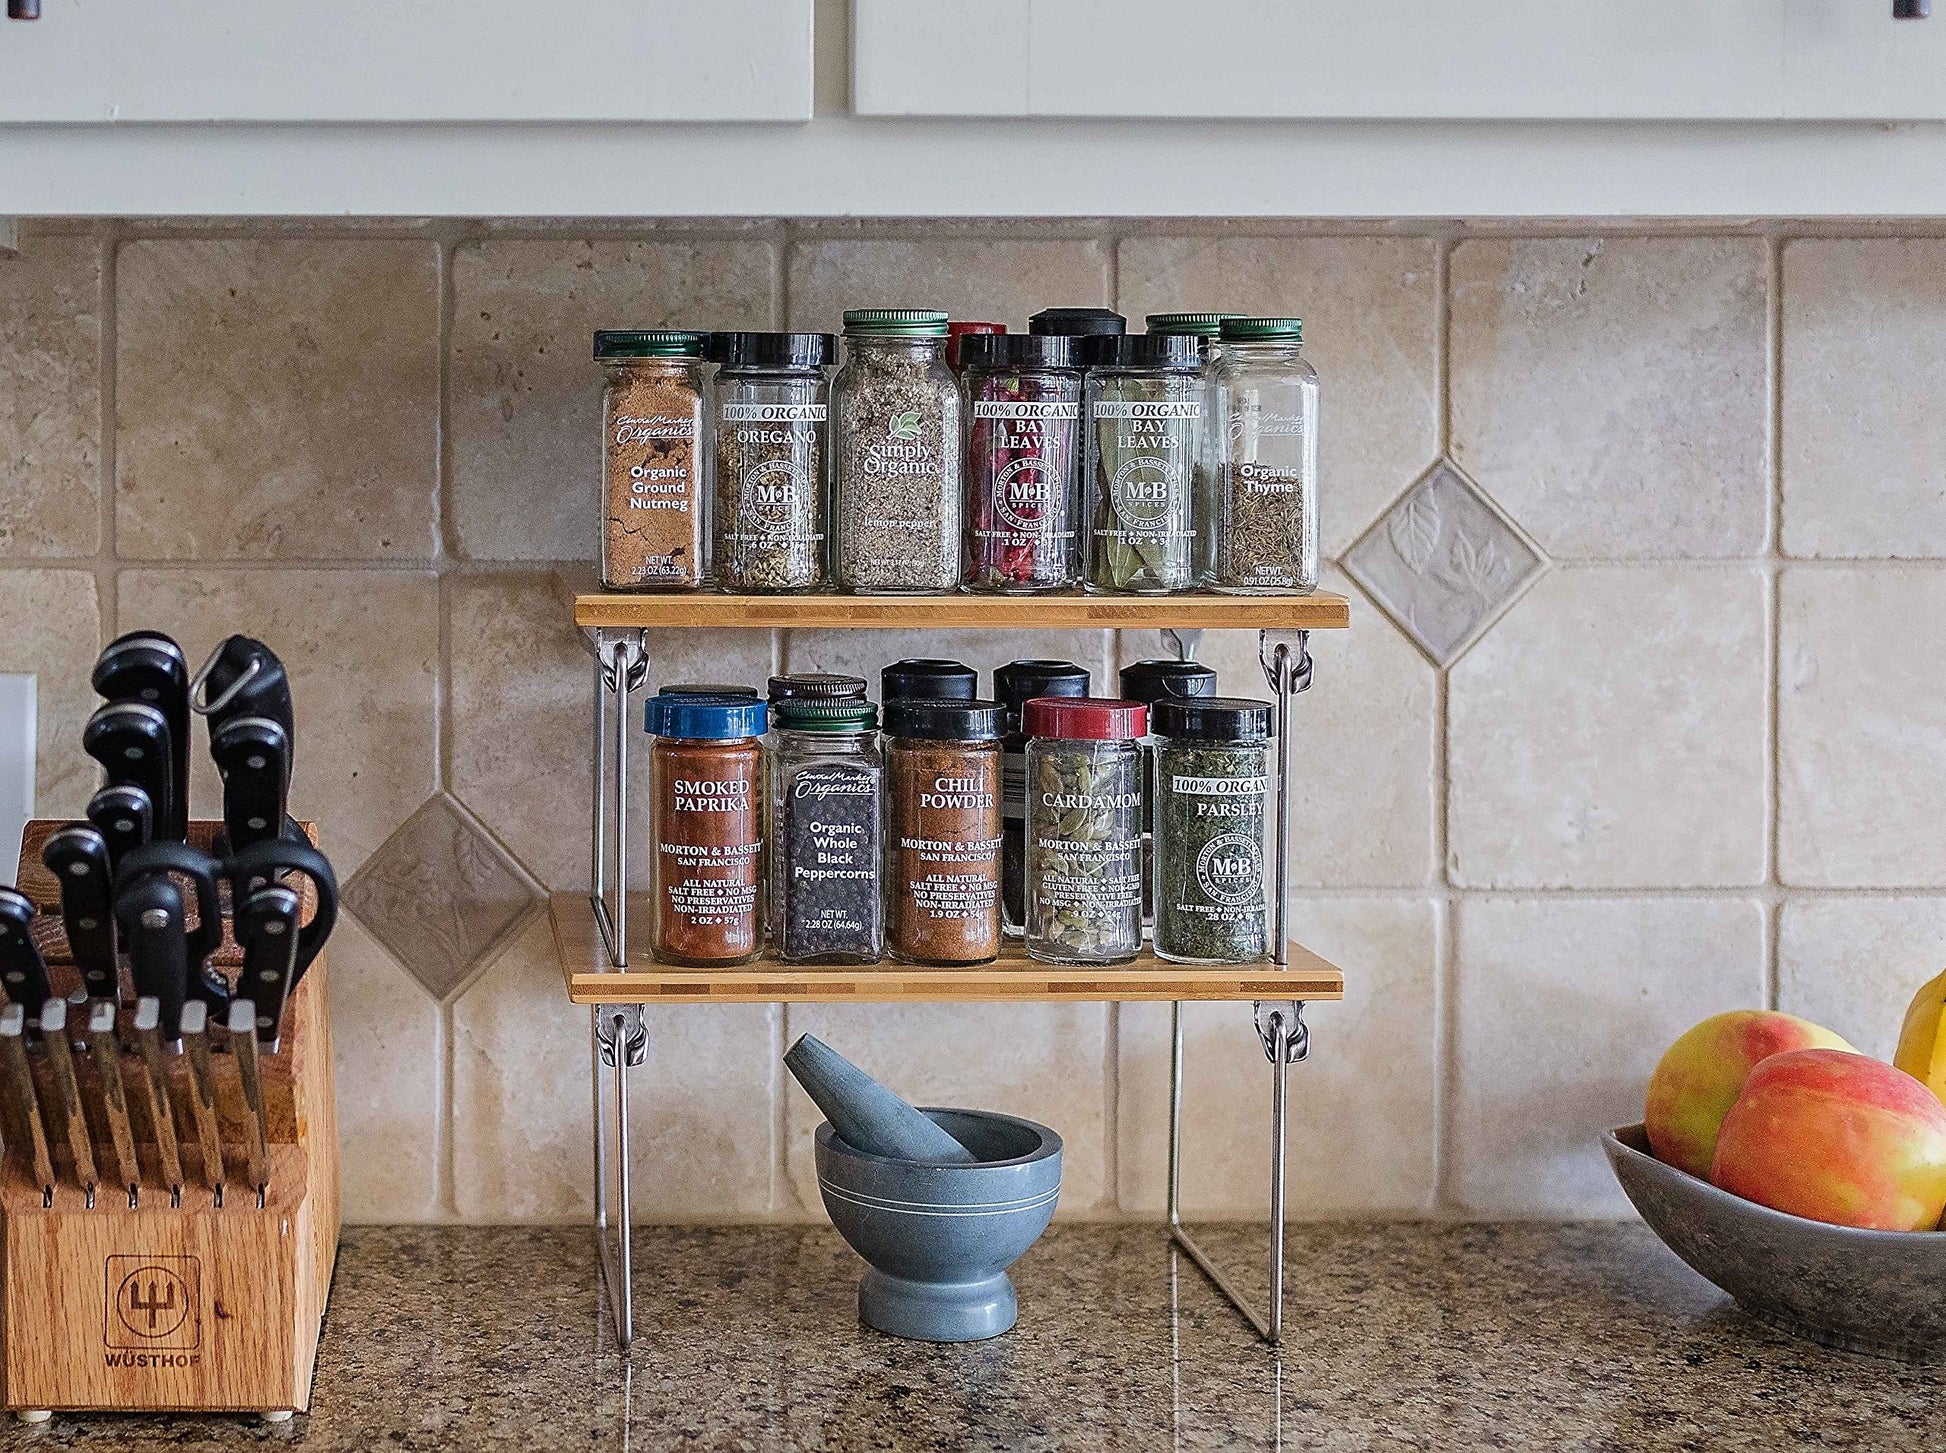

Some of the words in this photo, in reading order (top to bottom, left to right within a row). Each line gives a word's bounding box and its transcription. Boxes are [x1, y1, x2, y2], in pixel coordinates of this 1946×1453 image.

[724, 406, 757, 420] 100%
[761, 406, 827, 420] ORGANIC
[975, 404, 1010, 417] 100%
[1095, 404, 1127, 417] 100%
[1131, 403, 1199, 417] ORGANIC
[1016, 420, 1049, 433] BAY
[1132, 419, 1167, 433] BAY
[616, 425, 694, 444] Organics
[737, 430, 817, 444] OREGANO
[1001, 436, 1060, 449] LEAVES
[1117, 436, 1179, 449] LEAVES
[869, 442, 931, 462] Simply
[630, 465, 687, 481] Organic
[863, 456, 936, 477] Organic
[1240, 464, 1298, 481] Organic
[996, 466, 1013, 498] MORTON
[1113, 466, 1130, 496] MORTON
[631, 482, 686, 494] Ground
[1244, 480, 1294, 496] Thyme
[630, 498, 688, 512] Nutmeg
[1000, 506, 1015, 522] SAN
[1117, 505, 1132, 521] SAN
[759, 541, 773, 549] OZ
[1012, 538, 1027, 546] OZ
[1128, 537, 1143, 545] OZ
[645, 555, 660, 565] NET
[648, 566, 658, 575] OZ
[1255, 566, 1270, 575] NET
[1259, 577, 1270, 586] OZ
[674, 780, 750, 795] SMOKED
[795, 781, 873, 801] Organics
[935, 778, 984, 793] CHILI
[1174, 779, 1212, 793] 100%
[1216, 778, 1269, 793] ORGAN
[675, 796, 749, 812] PAPRIKA
[920, 793, 994, 809] POWDER
[1042, 792, 1141, 809] CARDAMOM
[1197, 802, 1264, 816] PARSLEY
[809, 821, 862, 836] Organic
[660, 843, 708, 856] MORTON
[711, 846, 721, 856] &
[724, 842, 762, 856] BASSETT
[813, 837, 858, 849] Whole
[901, 838, 951, 851] MORTON
[954, 841, 965, 851] &
[967, 838, 1002, 851] BASSETT
[1039, 838, 1089, 851] MORTON
[1092, 842, 1102, 851] &
[1105, 838, 1141, 851] BASSETT
[677, 857, 697, 866] SAN
[698, 857, 750, 867] FRANCISCO
[817, 852, 853, 864] Black
[920, 852, 940, 861] SAN
[942, 852, 992, 862] FRANCISCO
[1057, 852, 1078, 862] SAN
[1079, 852, 1130, 862] FRANCISCO
[1198, 843, 1216, 873] MORTON
[795, 866, 875, 881] Peppercorns
[925, 874, 944, 883] ALL
[946, 874, 988, 883] NATURAL
[1042, 874, 1057, 883] ALL
[1057, 875, 1100, 885] NATURAL
[683, 879, 701, 887] ALL
[703, 879, 745, 888] NATURAL
[910, 881, 932, 891] SALT
[934, 883, 958, 892] FREE
[968, 882, 982, 892] NO
[983, 881, 998, 890] MSG
[1042, 882, 1074, 892] GLUTEN
[1076, 884, 1098, 893] FREE
[1203, 881, 1218, 897] SAN
[668, 886, 689, 895] SALT
[691, 888, 715, 897] FREE
[725, 887, 740, 896] NO
[741, 885, 757, 895] MSG
[913, 890, 928, 899] NO
[929, 890, 996, 901] PRESERVATIVES
[1054, 891, 1116, 901] PRESERVATIVE
[671, 895, 685, 904] NO
[687, 895, 755, 906] PRESERVATIVES
[916, 899, 994, 909] NON-IRRADIATED
[1039, 897, 1051, 905] NO
[1052, 898, 1071, 908] MSG
[673, 904, 753, 914] NON-IRRADIATED
[820, 910, 835, 919] NET
[930, 910, 944, 919] 1.9
[945, 910, 960, 919] OZ
[1081, 910, 1096, 919] OZ
[1176, 904, 1194, 912] SALT
[1195, 905, 1215, 913] FREE
[691, 916, 697, 925] 2
[698, 916, 713, 925] OZ
[724, 916, 739, 926] 57g
[1206, 913, 1219, 921] .28
[1221, 913, 1235, 921] OZ
[805, 920, 821, 929] 2.28
[821, 920, 832, 929] OZ
[833, 919, 863, 931] (64.64g)
[105, 1350, 200, 1368] WÜSTHOF
